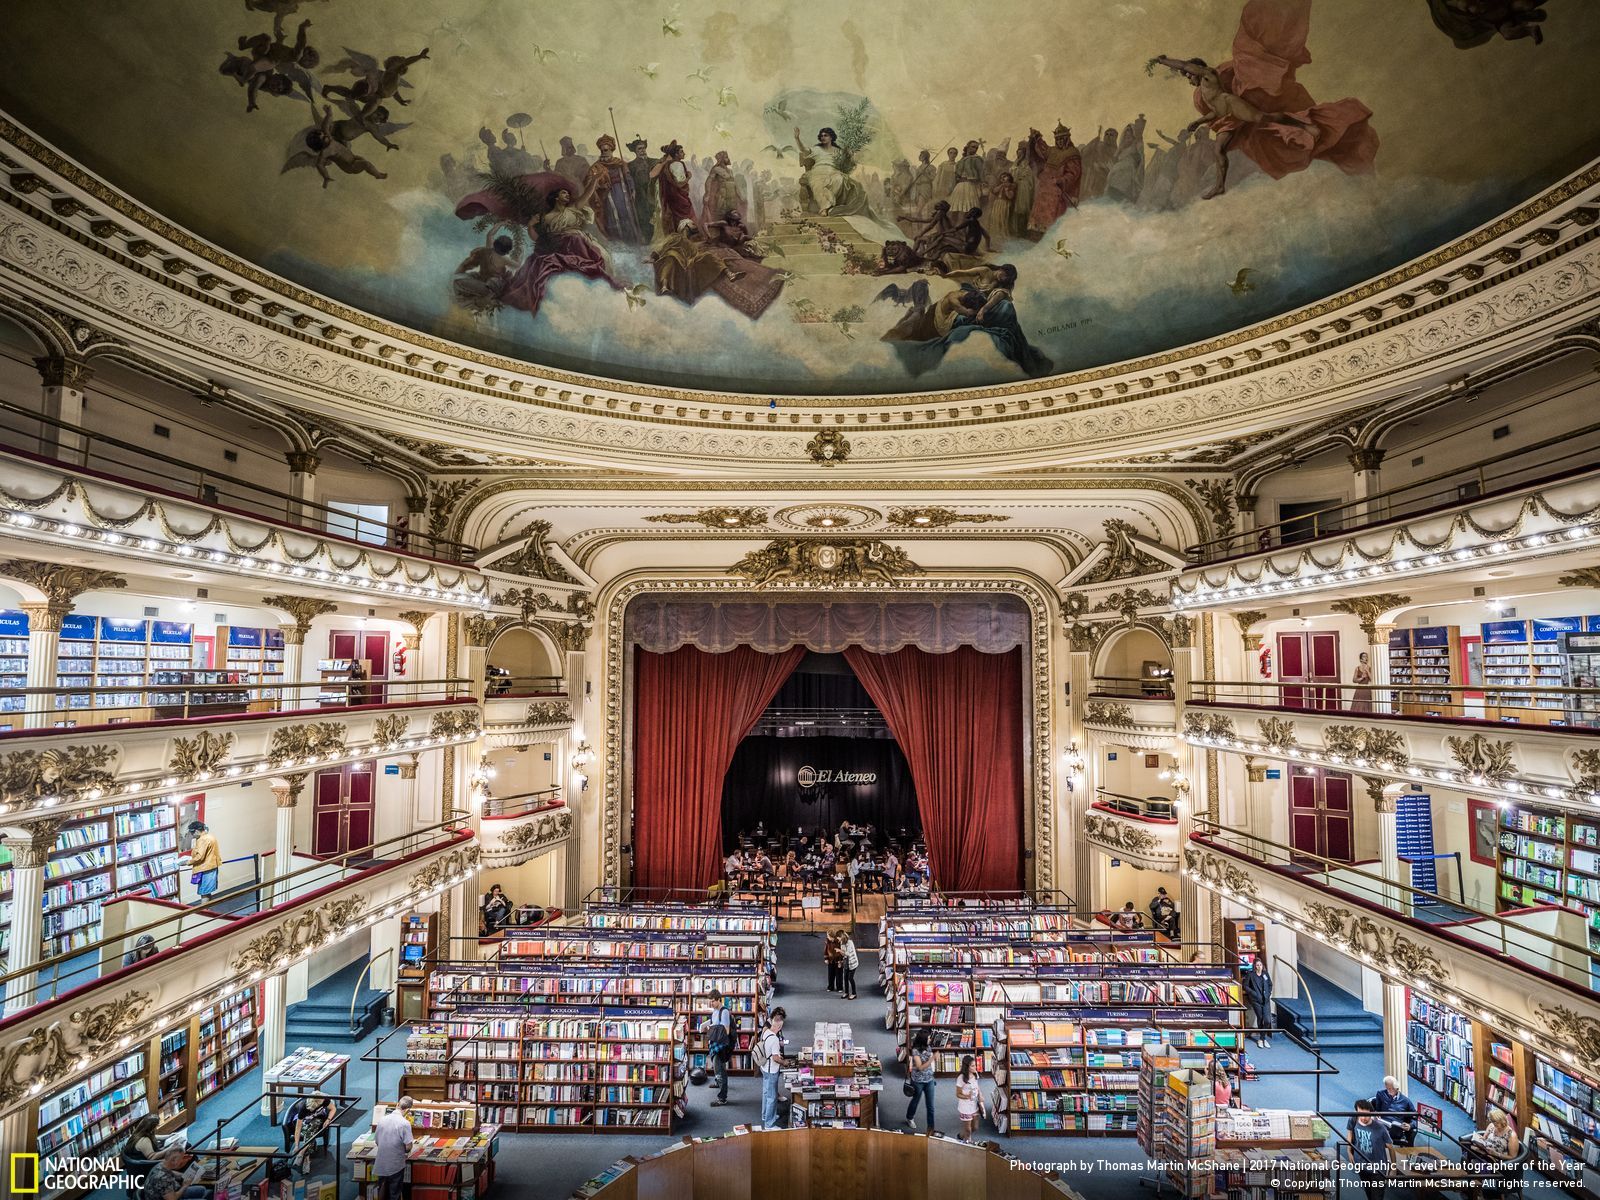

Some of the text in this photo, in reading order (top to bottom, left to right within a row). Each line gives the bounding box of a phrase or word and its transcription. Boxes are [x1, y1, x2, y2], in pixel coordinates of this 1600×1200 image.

[1047, 321, 1077, 334] ORLANDI
[816, 769, 877, 783] El Ateneo
